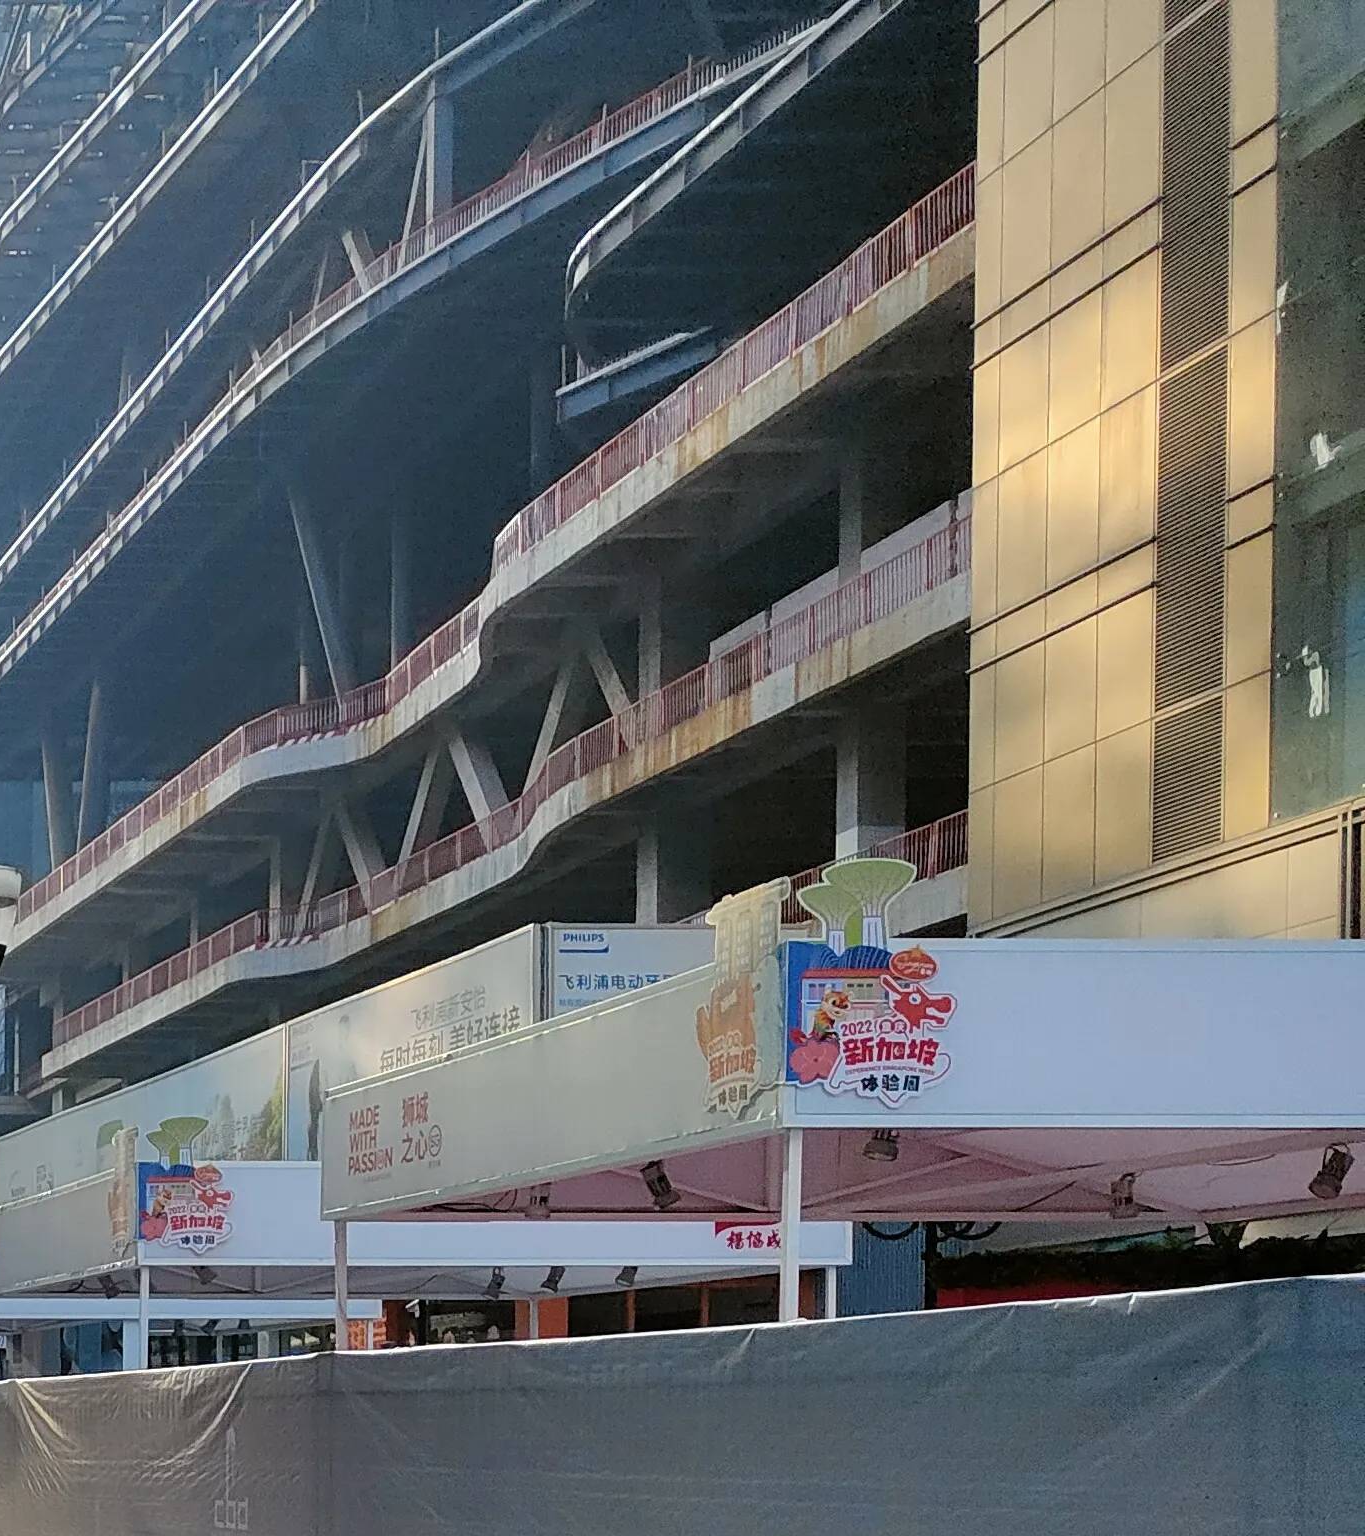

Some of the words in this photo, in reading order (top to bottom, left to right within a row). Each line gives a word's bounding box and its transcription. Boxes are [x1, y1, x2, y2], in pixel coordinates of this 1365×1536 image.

[563, 933, 605, 943] PHILIPS
[380, 1030, 444, 1073] 每时每刻
[450, 1005, 521, 1051] 美好连接
[841, 1020, 872, 1036] 2022
[843, 1037, 939, 1066] 新加坡
[861, 1074, 920, 1093] 体验周
[349, 1104, 380, 1132] MADE
[349, 1128, 378, 1153] WITH
[170, 1215, 225, 1231] 新加坡
